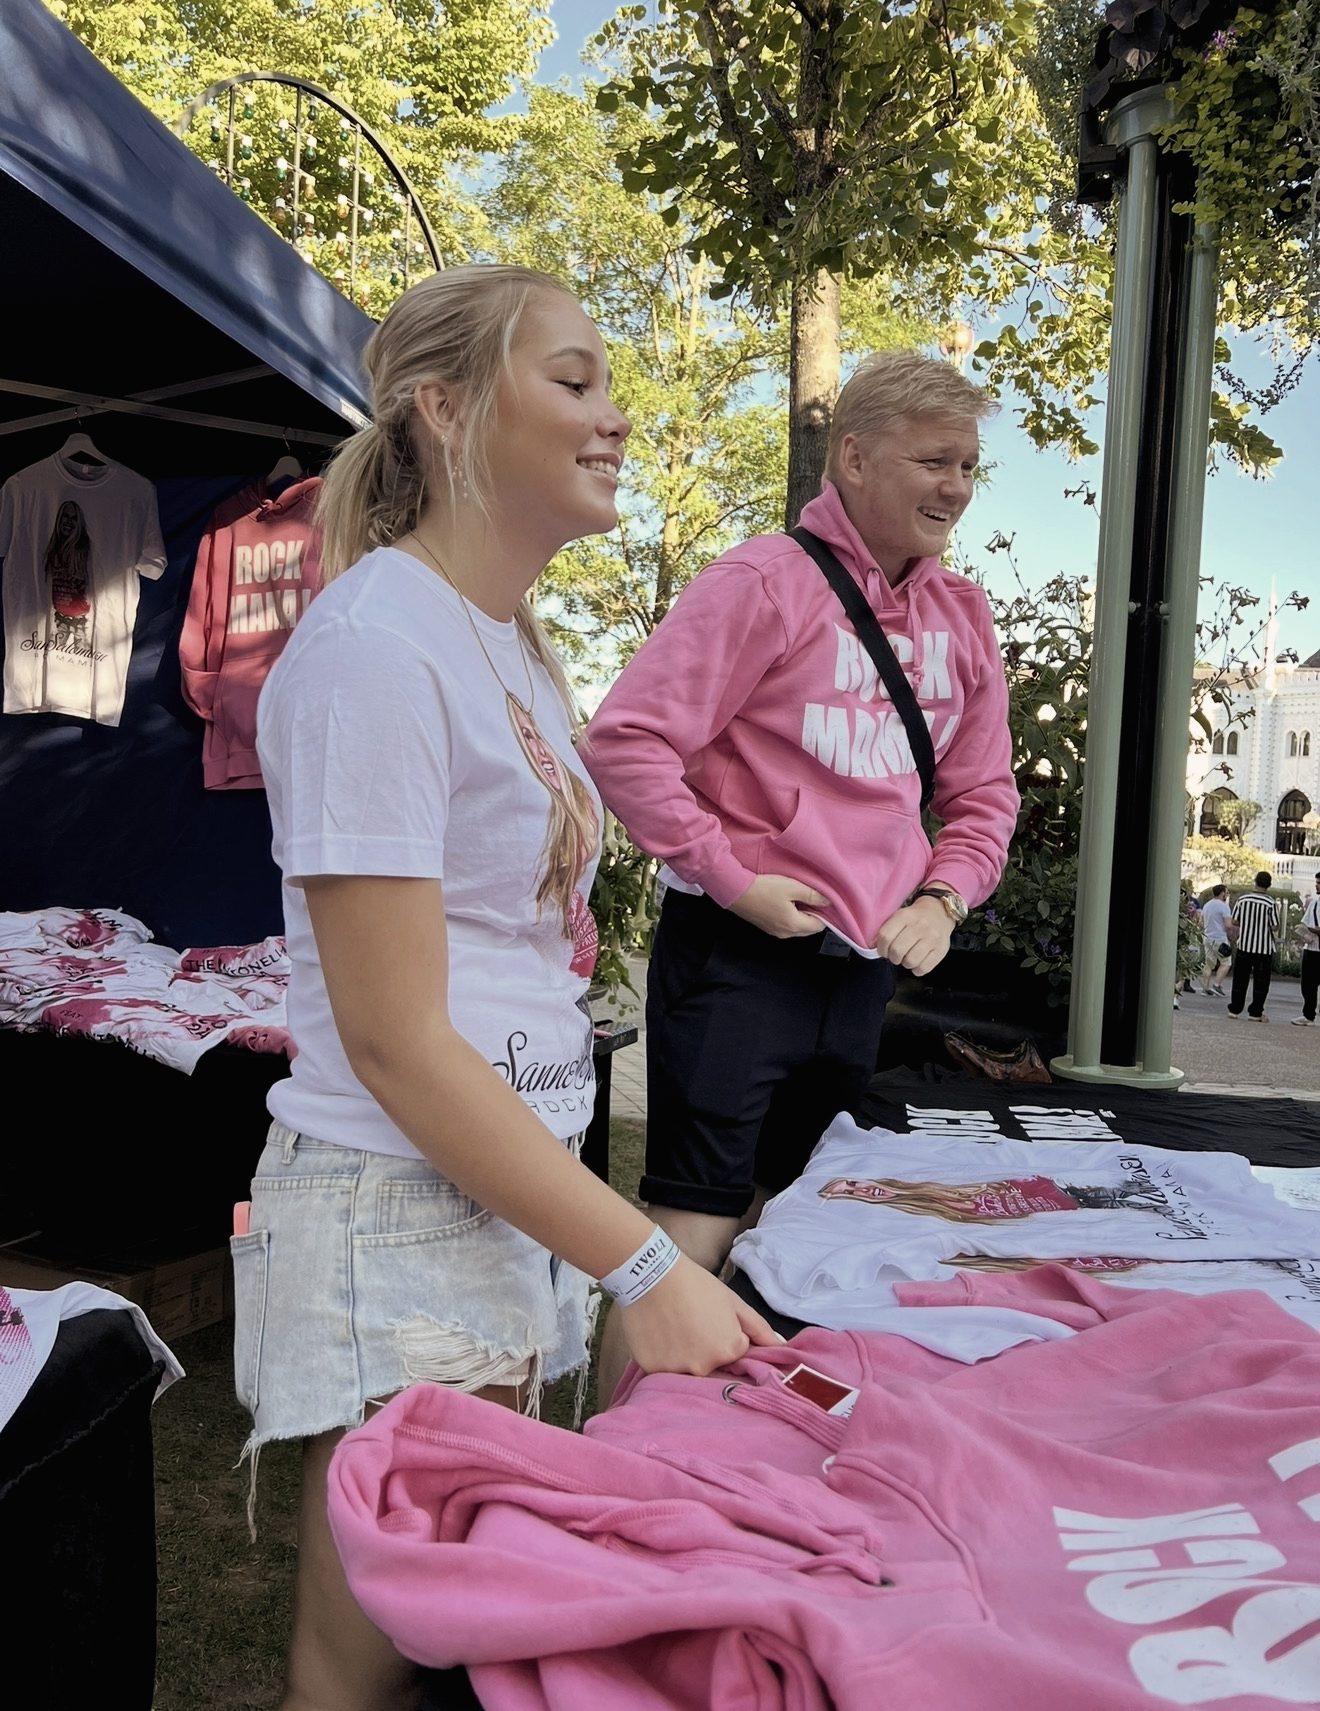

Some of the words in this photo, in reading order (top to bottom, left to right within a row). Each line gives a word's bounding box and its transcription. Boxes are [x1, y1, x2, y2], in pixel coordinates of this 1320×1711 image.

[235, 540, 304, 585] ROCK
[186, 959, 215, 972] THE
[492, 1030, 578, 1093] Sanne
[629, 1238, 667, 1277] TIVOLI
